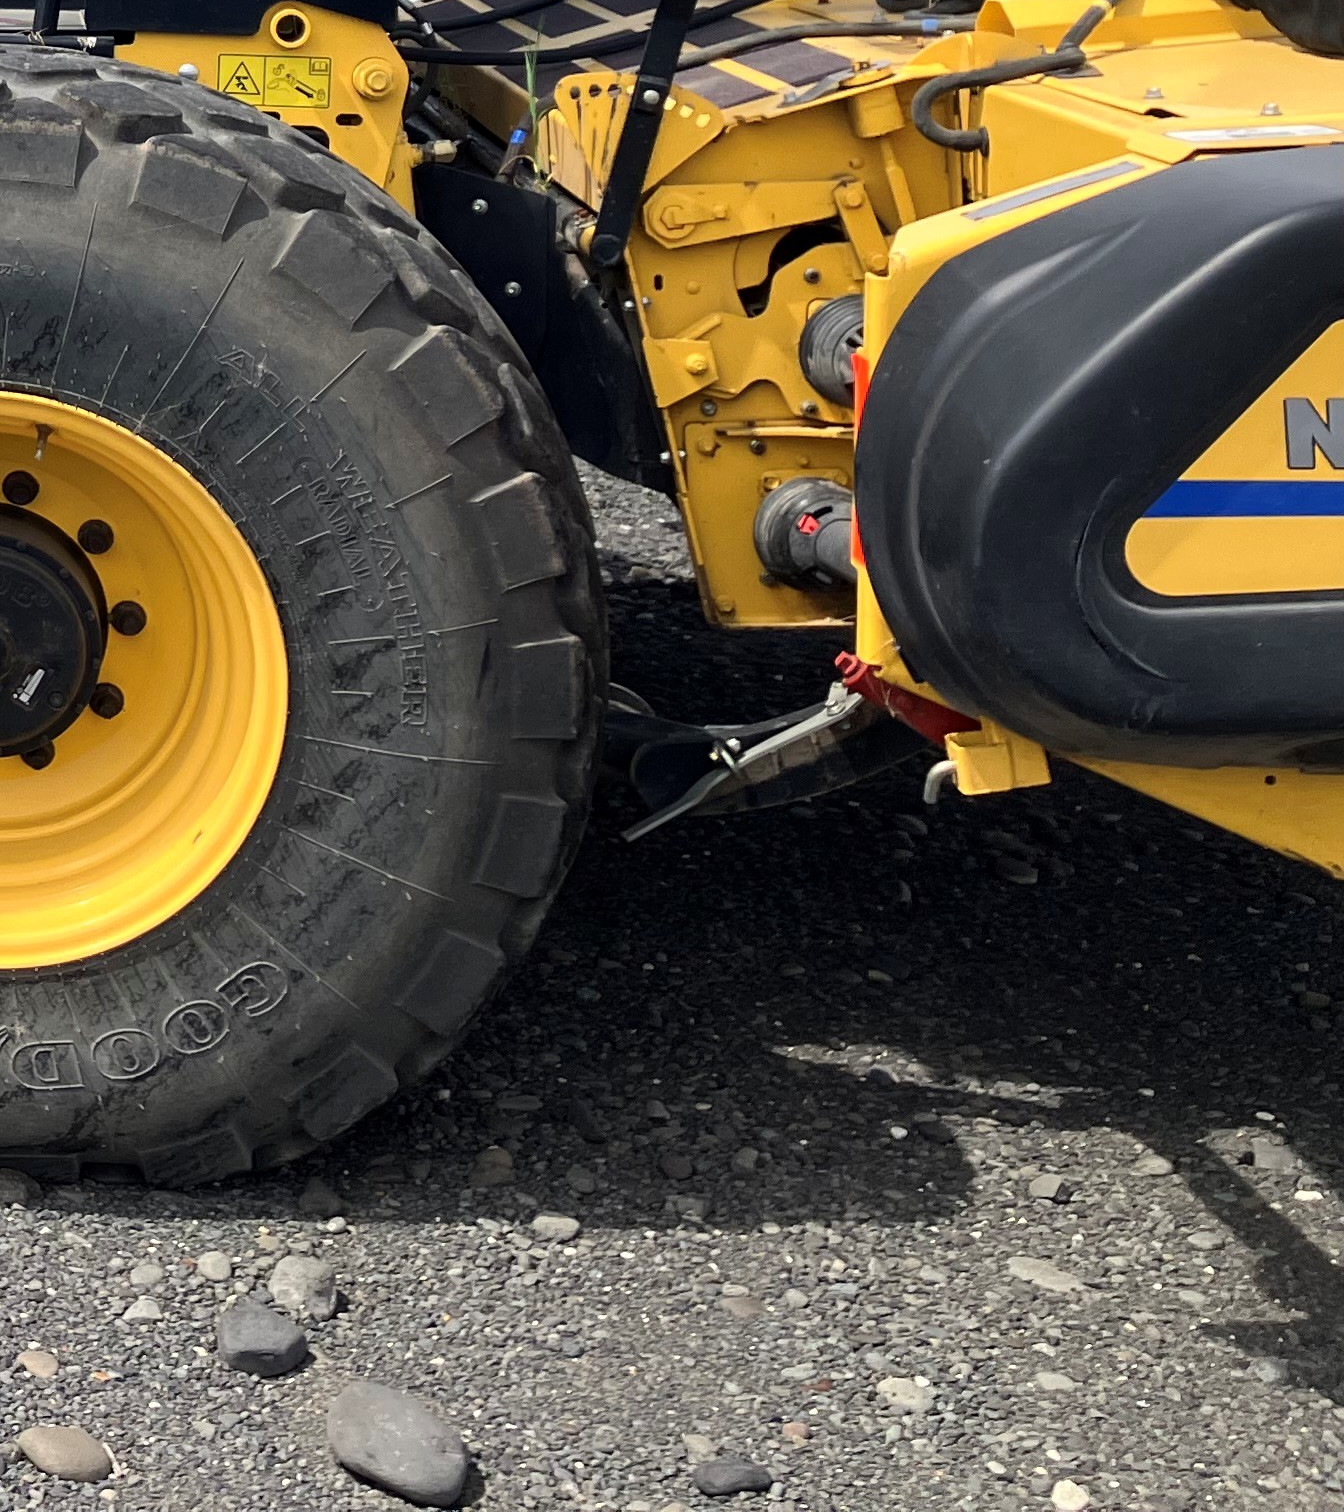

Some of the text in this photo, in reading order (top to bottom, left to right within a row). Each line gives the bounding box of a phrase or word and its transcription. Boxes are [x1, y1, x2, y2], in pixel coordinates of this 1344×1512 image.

[217, 347, 307, 433] ALL
[307, 476, 373, 588] RADIAL
[325, 448, 430, 727] WEATHER
